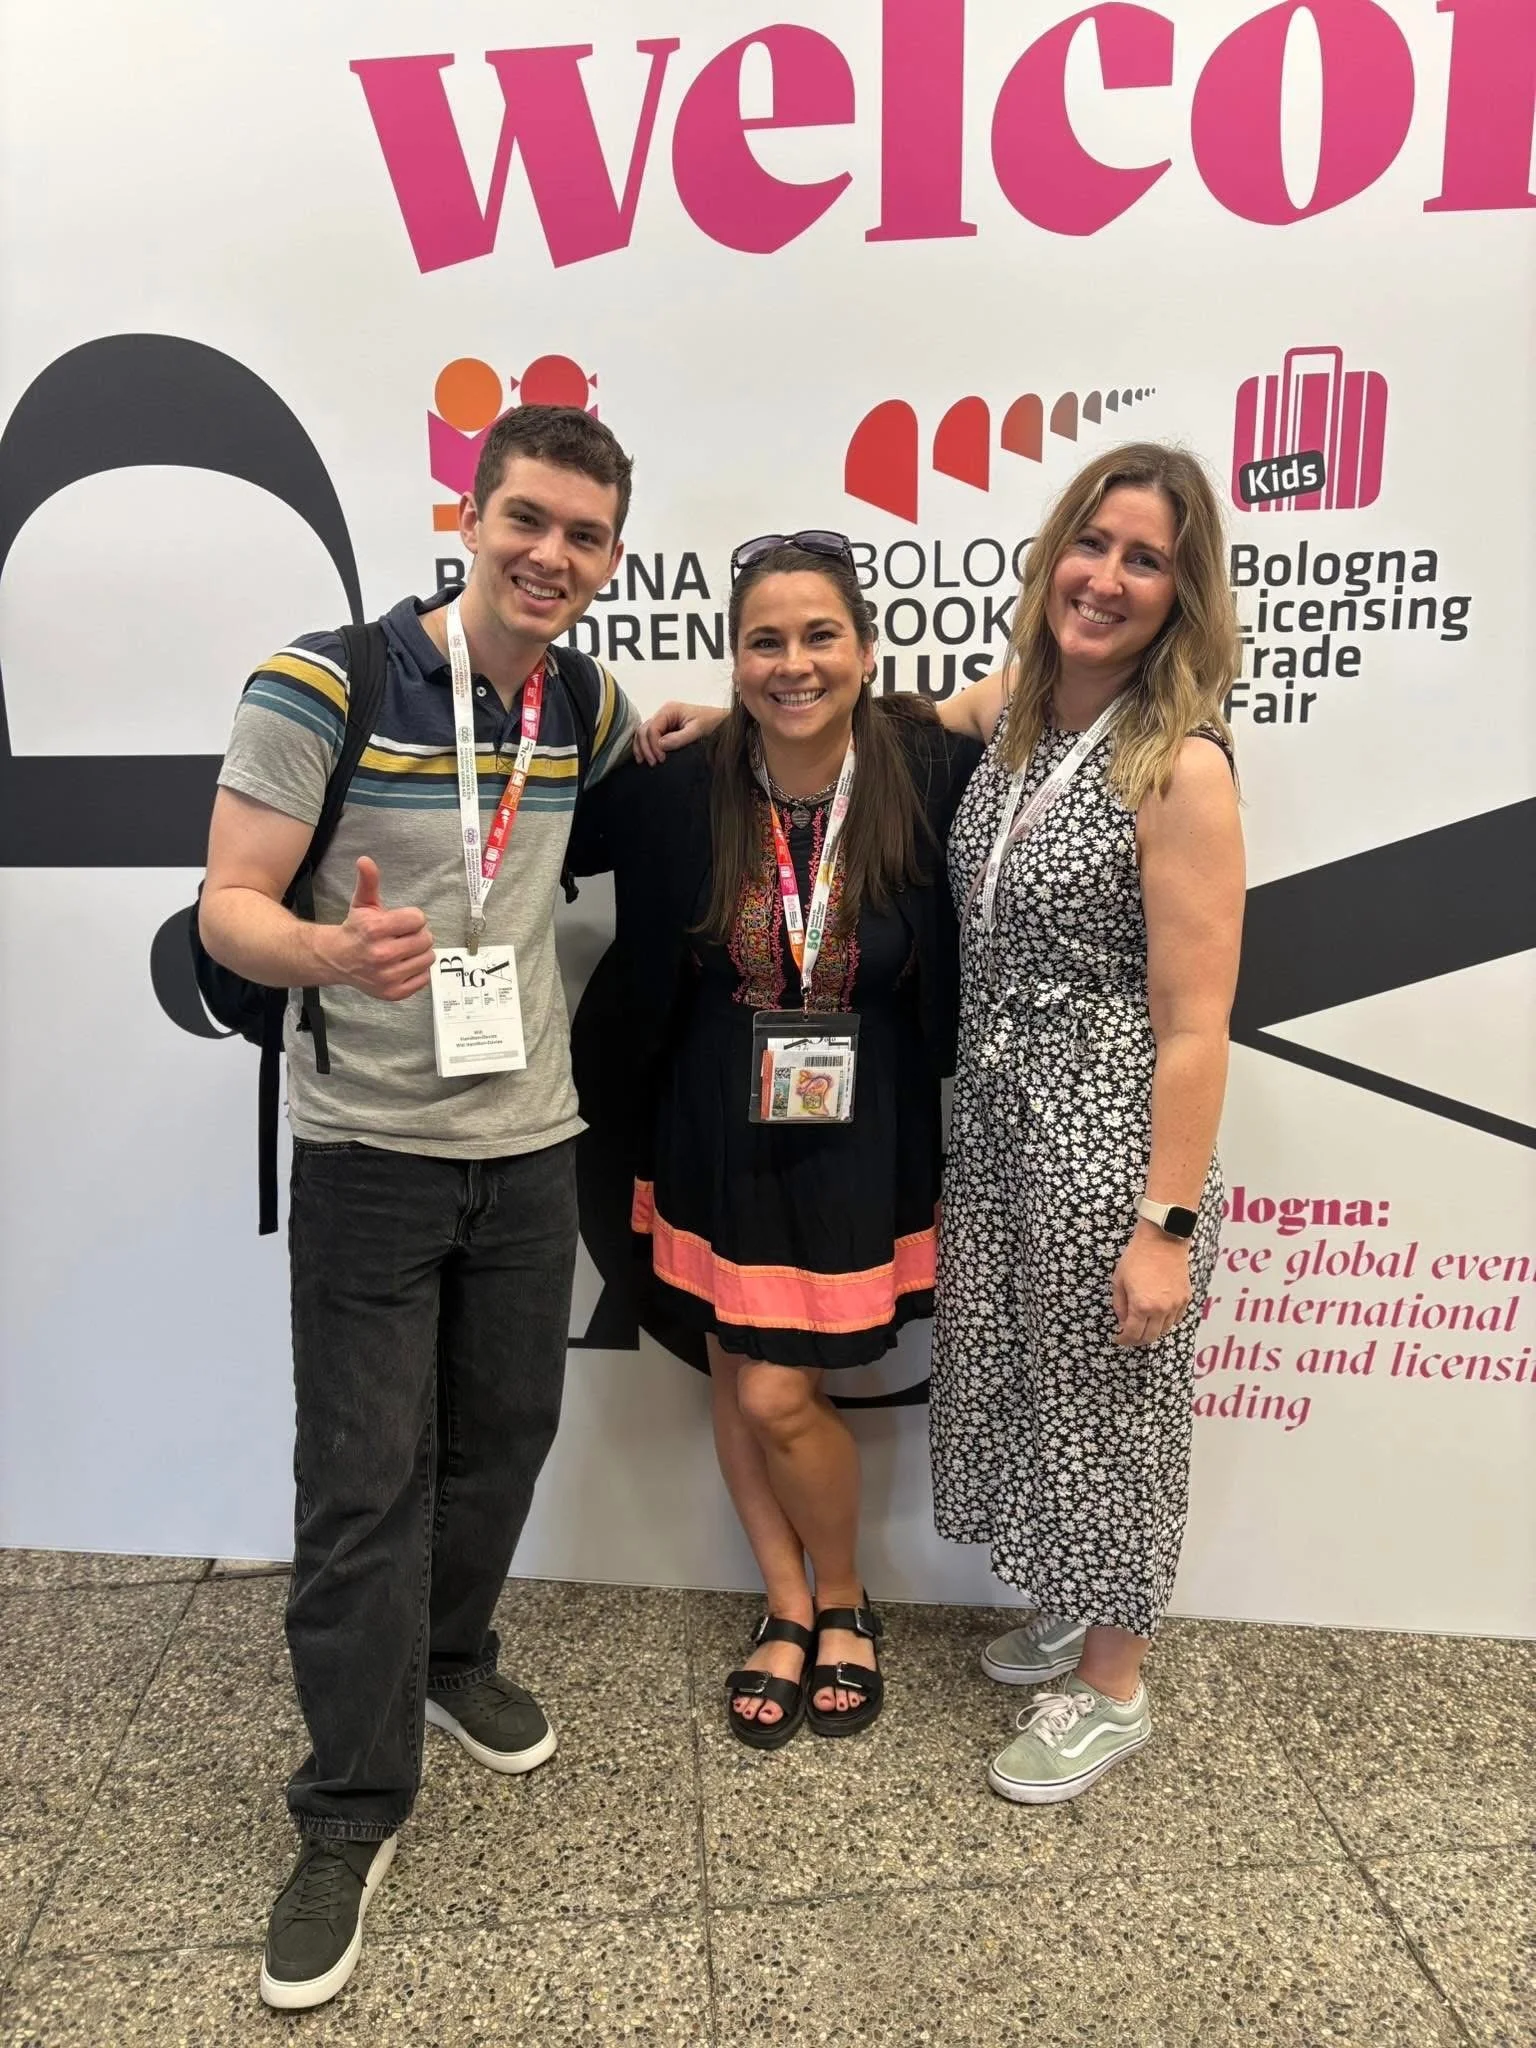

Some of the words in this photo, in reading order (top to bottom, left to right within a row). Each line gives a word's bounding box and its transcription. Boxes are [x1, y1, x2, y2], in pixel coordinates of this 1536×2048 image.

[1248, 459, 1317, 496] Kids
[1230, 540, 1438, 597] Bologna
[1223, 680, 1317, 724] Fair
[1220, 1186, 1390, 1236] logna:
[1283, 1238, 1419, 1286] global
[1431, 1252, 1536, 1284] even
[1234, 1287, 1520, 1333] international
[1194, 1335, 1283, 1380] ghts
[1296, 1340, 1379, 1376] and
[1193, 1383, 1312, 1432] ading
